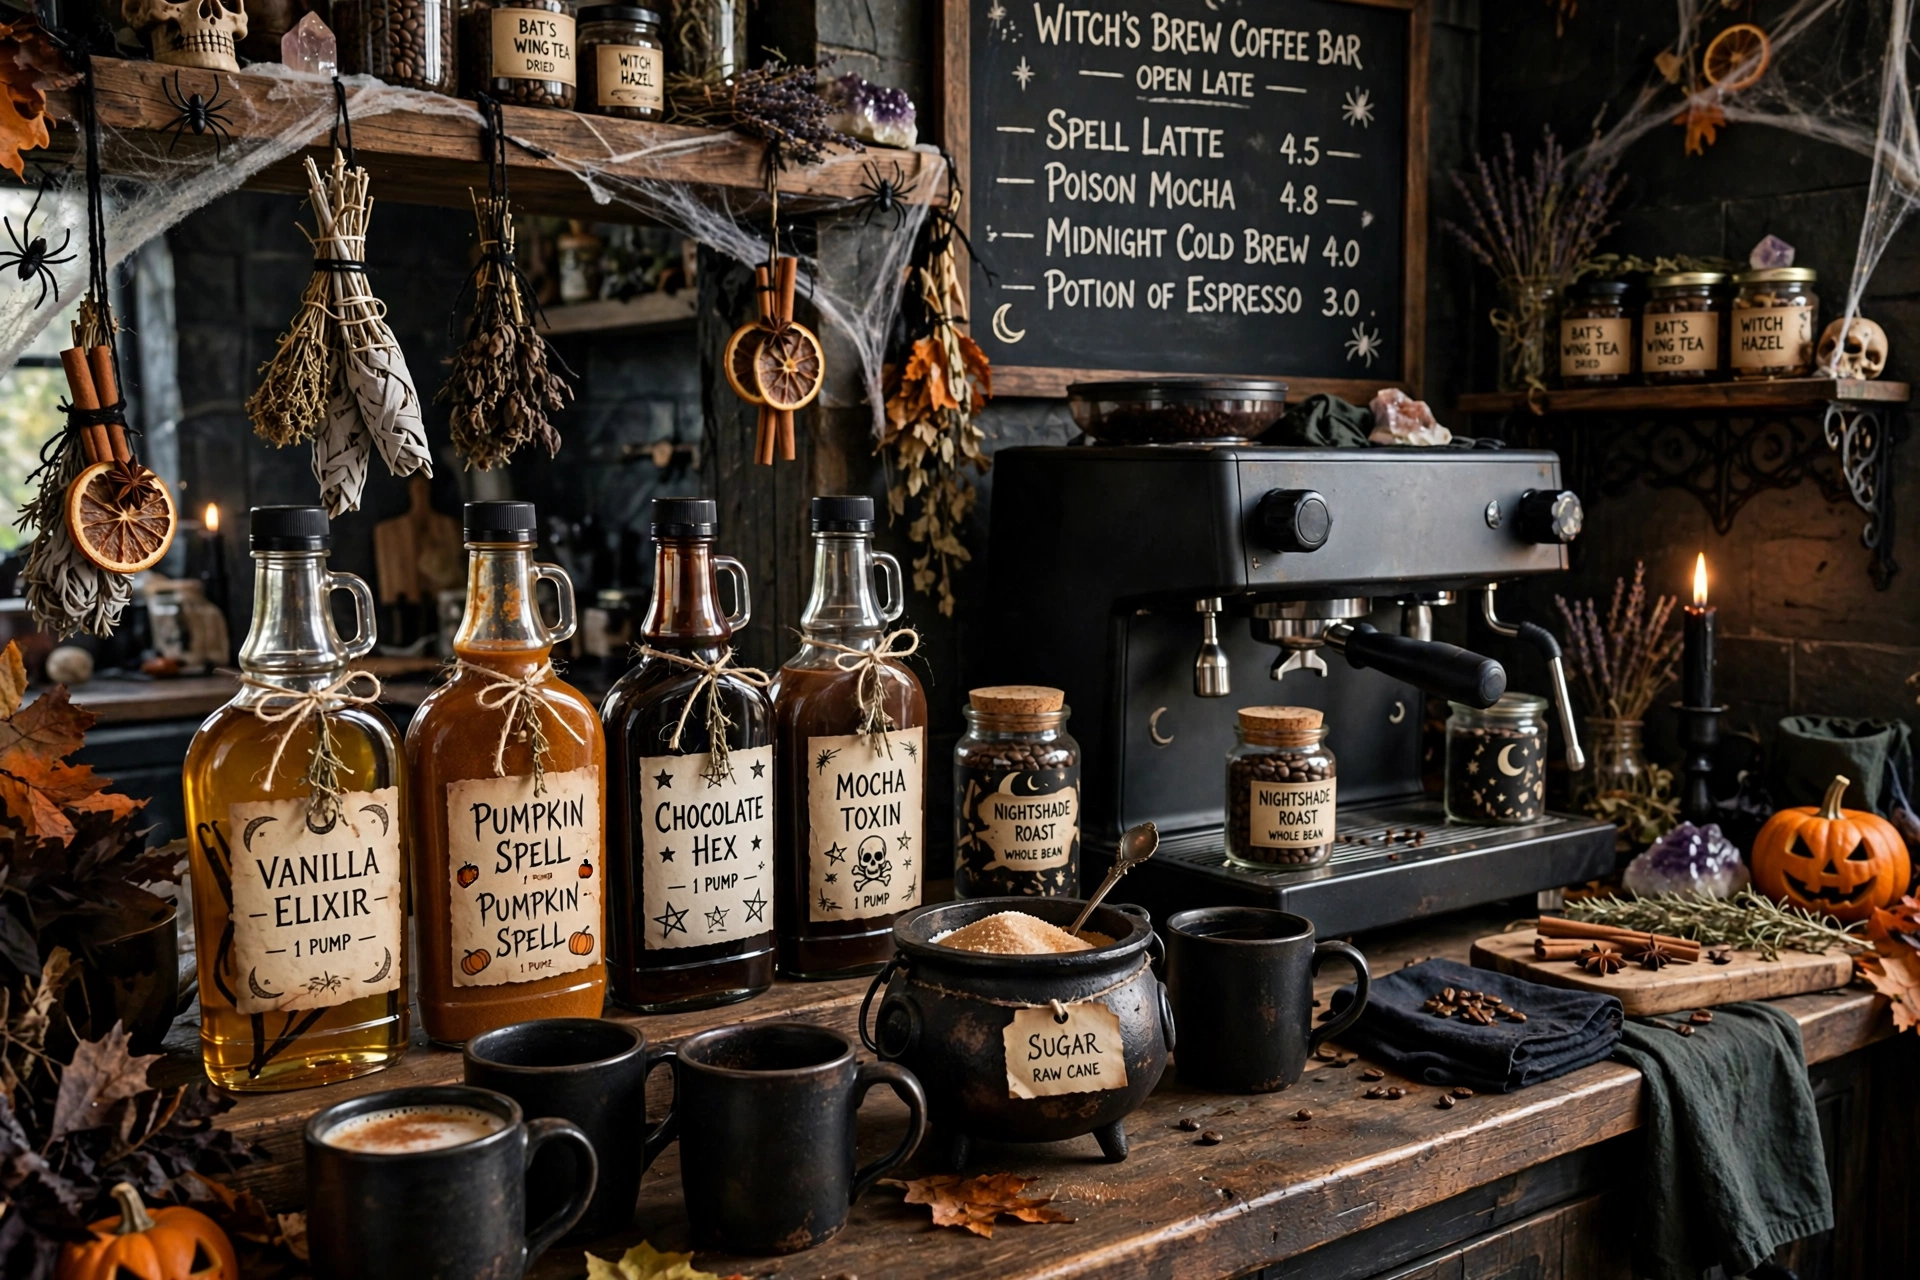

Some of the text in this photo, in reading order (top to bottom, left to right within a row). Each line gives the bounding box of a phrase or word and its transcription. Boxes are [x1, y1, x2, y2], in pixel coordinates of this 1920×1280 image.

[519, 19, 557, 38] BAT'S
[1033, 2, 1363, 71] WITCH'S BREW COFFEE BAR
[514, 38, 570, 59] WING TEA
[526, 59, 555, 73] DRIED
[619, 52, 651, 70] WITCH
[621, 70, 654, 87] HAZEL
[1136, 65, 1254, 98] OPEN LATE
[1046, 109, 1319, 166] SPELL LATTE 4.5
[1045, 162, 1319, 215] POISON MOCHA 4.8
[1046, 217, 1360, 268] MIDNIGHT COLD BREW 4.0
[1044, 269, 1360, 317] POTION OF ESPRESSO 3.0
[1740, 316, 1784, 332] WITCH
[1563, 342, 1619, 356] WING TEA
[1645, 336, 1704, 353] WING TEA
[1742, 336, 1784, 350] HAZEL
[1575, 359, 1600, 369] DRIED
[1657, 355, 1684, 365] DRIED
[835, 769, 906, 800] MOCHA
[1258, 788, 1331, 808] NIGHTSHADE
[469, 793, 584, 842] PUMPKIN
[655, 795, 764, 833] CHOCOLATE
[840, 801, 901, 832] TOXIN
[993, 799, 1071, 822] NIGHTSHADE
[1278, 810, 1318, 826] ROAST
[1015, 823, 1057, 842] ROAST
[1268, 828, 1324, 841] WHOLE BEAN
[494, 835, 571, 875] SPELL
[692, 834, 738, 867] HEX
[1004, 845, 1063, 861] WHOLE BEAN
[256, 846, 380, 890] VANILLA
[693, 873, 739, 894] 1 PUMP
[275, 889, 371, 928] ELIXIR
[476, 881, 579, 927] PUMPKIN
[854, 892, 890, 909] 1 PUMP
[294, 934, 352, 958] 1 PUMP
[496, 921, 566, 959] SPELL
[1028, 1032, 1103, 1062] SUGAR
[1033, 1062, 1101, 1083] RAW CANE
